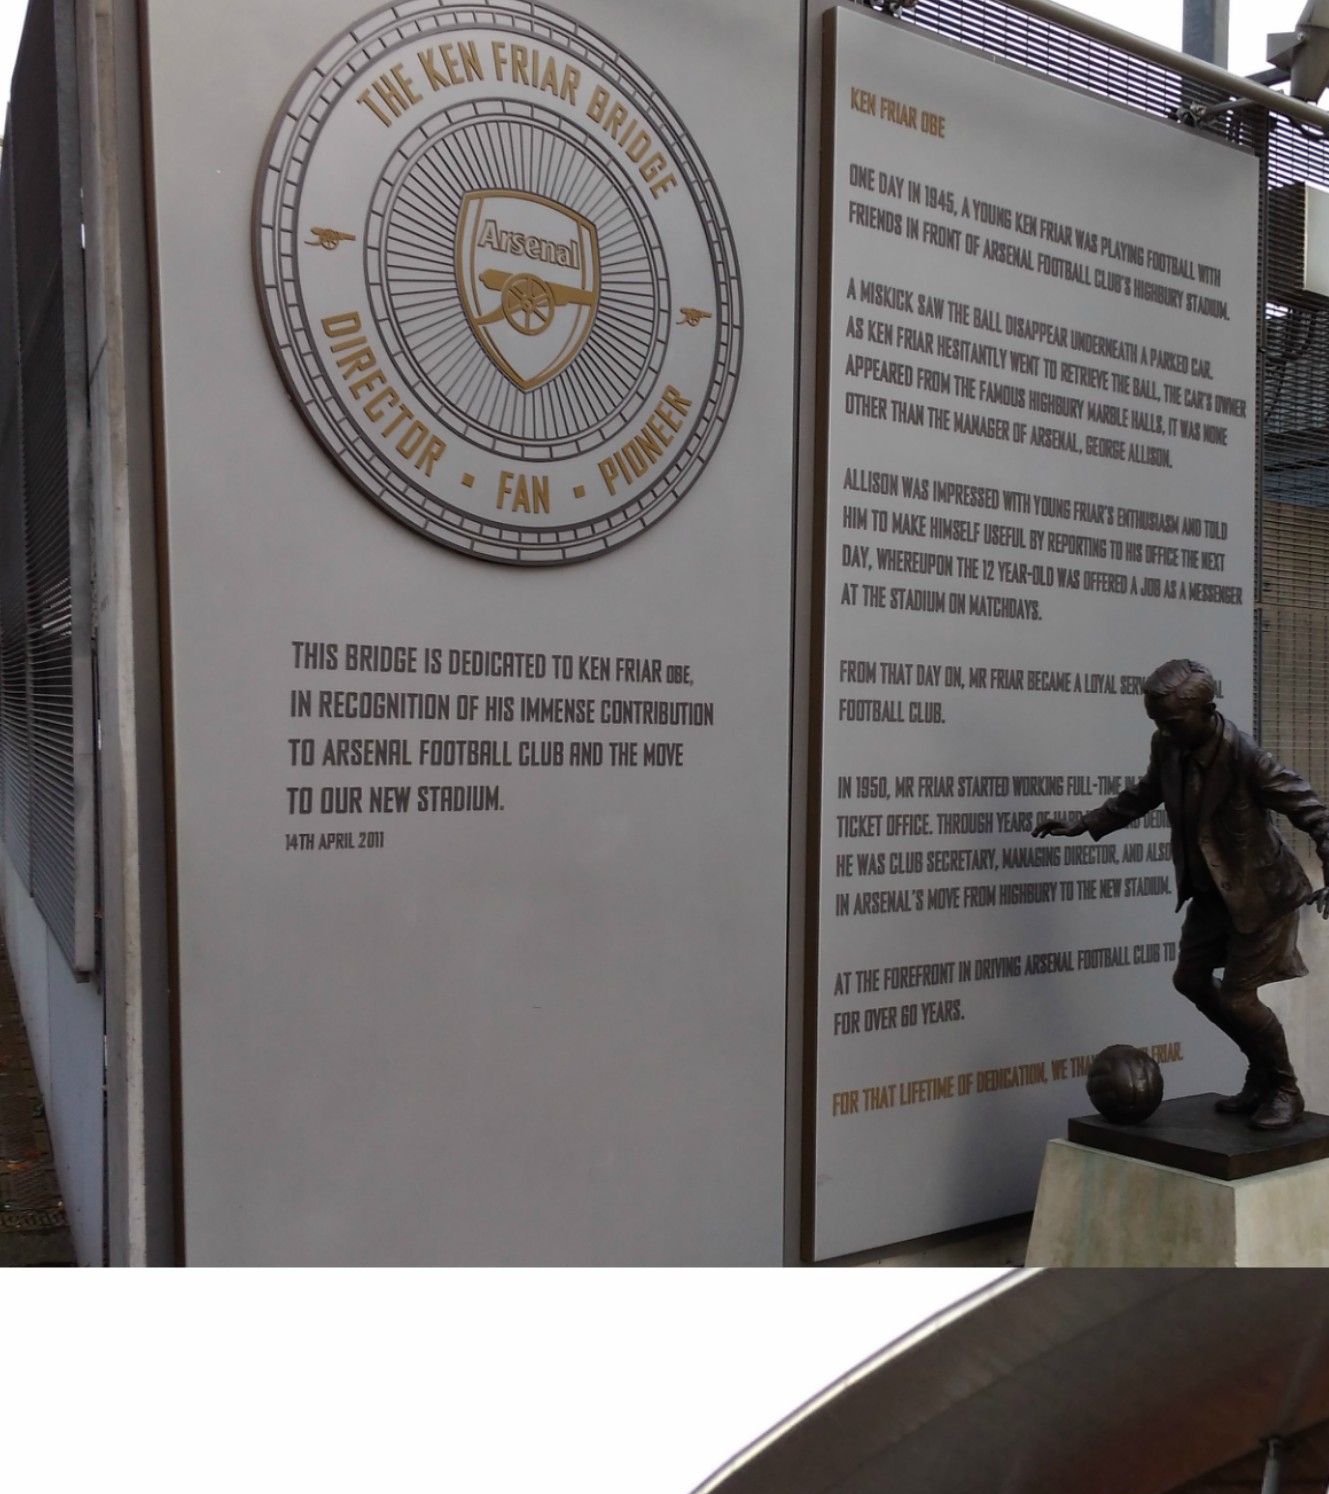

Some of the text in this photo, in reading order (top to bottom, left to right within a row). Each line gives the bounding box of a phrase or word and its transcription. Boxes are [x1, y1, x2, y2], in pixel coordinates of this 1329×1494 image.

[356, 40, 678, 199] THE KEN FRIAR BRIDGE
[851, 86, 945, 139] KEN FRIAR OBE
[477, 219, 580, 270] Arsenal
[849, 163, 1221, 287] ONE DAY IN 1945, A YOUNG KEN FRIAR WAS PLAYING FOOTBALL WITH
[320, 311, 693, 514] DIRECTOR FAN PIONEER
[843, 467, 1227, 541] ALLISON WAS IMPRESSED WITH YOUNG FRIAR'S ENTHUSIASM AND TOLD
[292, 642, 693, 686] THIS BRIDGE IS DEDICATED TO KEN FRIAR OBE,
[290, 690, 714, 726] IN RECOGNITION OF HIS IMMENSE CONTRIBUTION
[839, 699, 945, 724] FOOTBALL CLUB.
[288, 738, 683, 767] TO ARSENAL FOOTBALL CLUB AND THE MOVE
[287, 785, 505, 814] TO OUR NEW STADIUM.
[286, 832, 384, 851] 14TH APRIL 2011
[834, 999, 965, 1036] FOR OVER 60 YEARS.
[832, 1091, 859, 1117] FOR
[863, 1086, 896, 1112] THAT
[900, 1077, 954, 1106] LIFETIME
[958, 1074, 973, 1097] OF
[976, 1061, 1048, 1095] DEDICATION,
[1052, 1058, 1068, 1081] WE
[1071, 1050, 1098, 1078] THA
